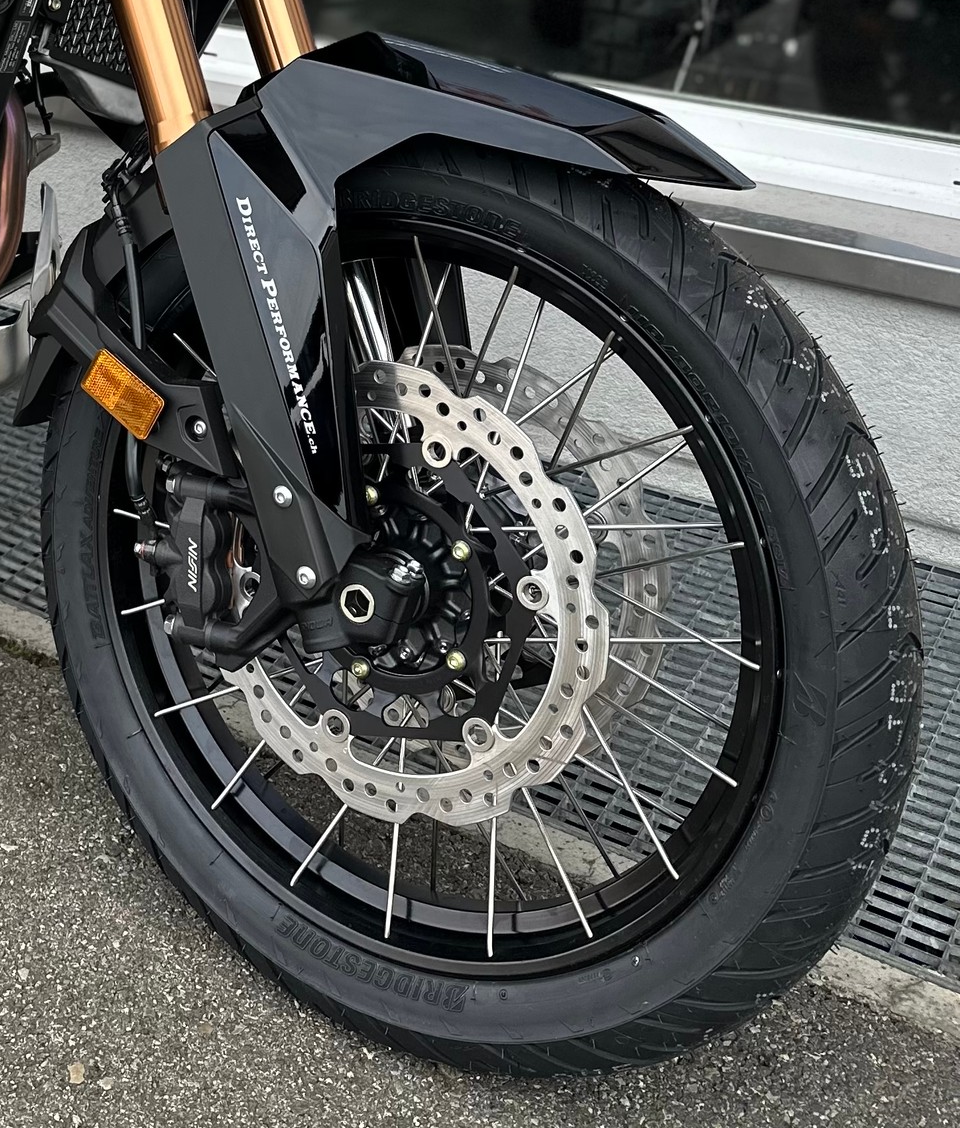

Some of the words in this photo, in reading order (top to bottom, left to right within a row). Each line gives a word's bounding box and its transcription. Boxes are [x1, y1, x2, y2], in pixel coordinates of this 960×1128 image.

[338, 189, 523, 238] BRIDGESTONE
[235, 196, 269, 276] DIRECT
[260, 278, 319, 455] PERFORMANCE.ch
[187, 536, 199, 593] NISSIN
[273, 915, 470, 1015] BRIDGESTONE
